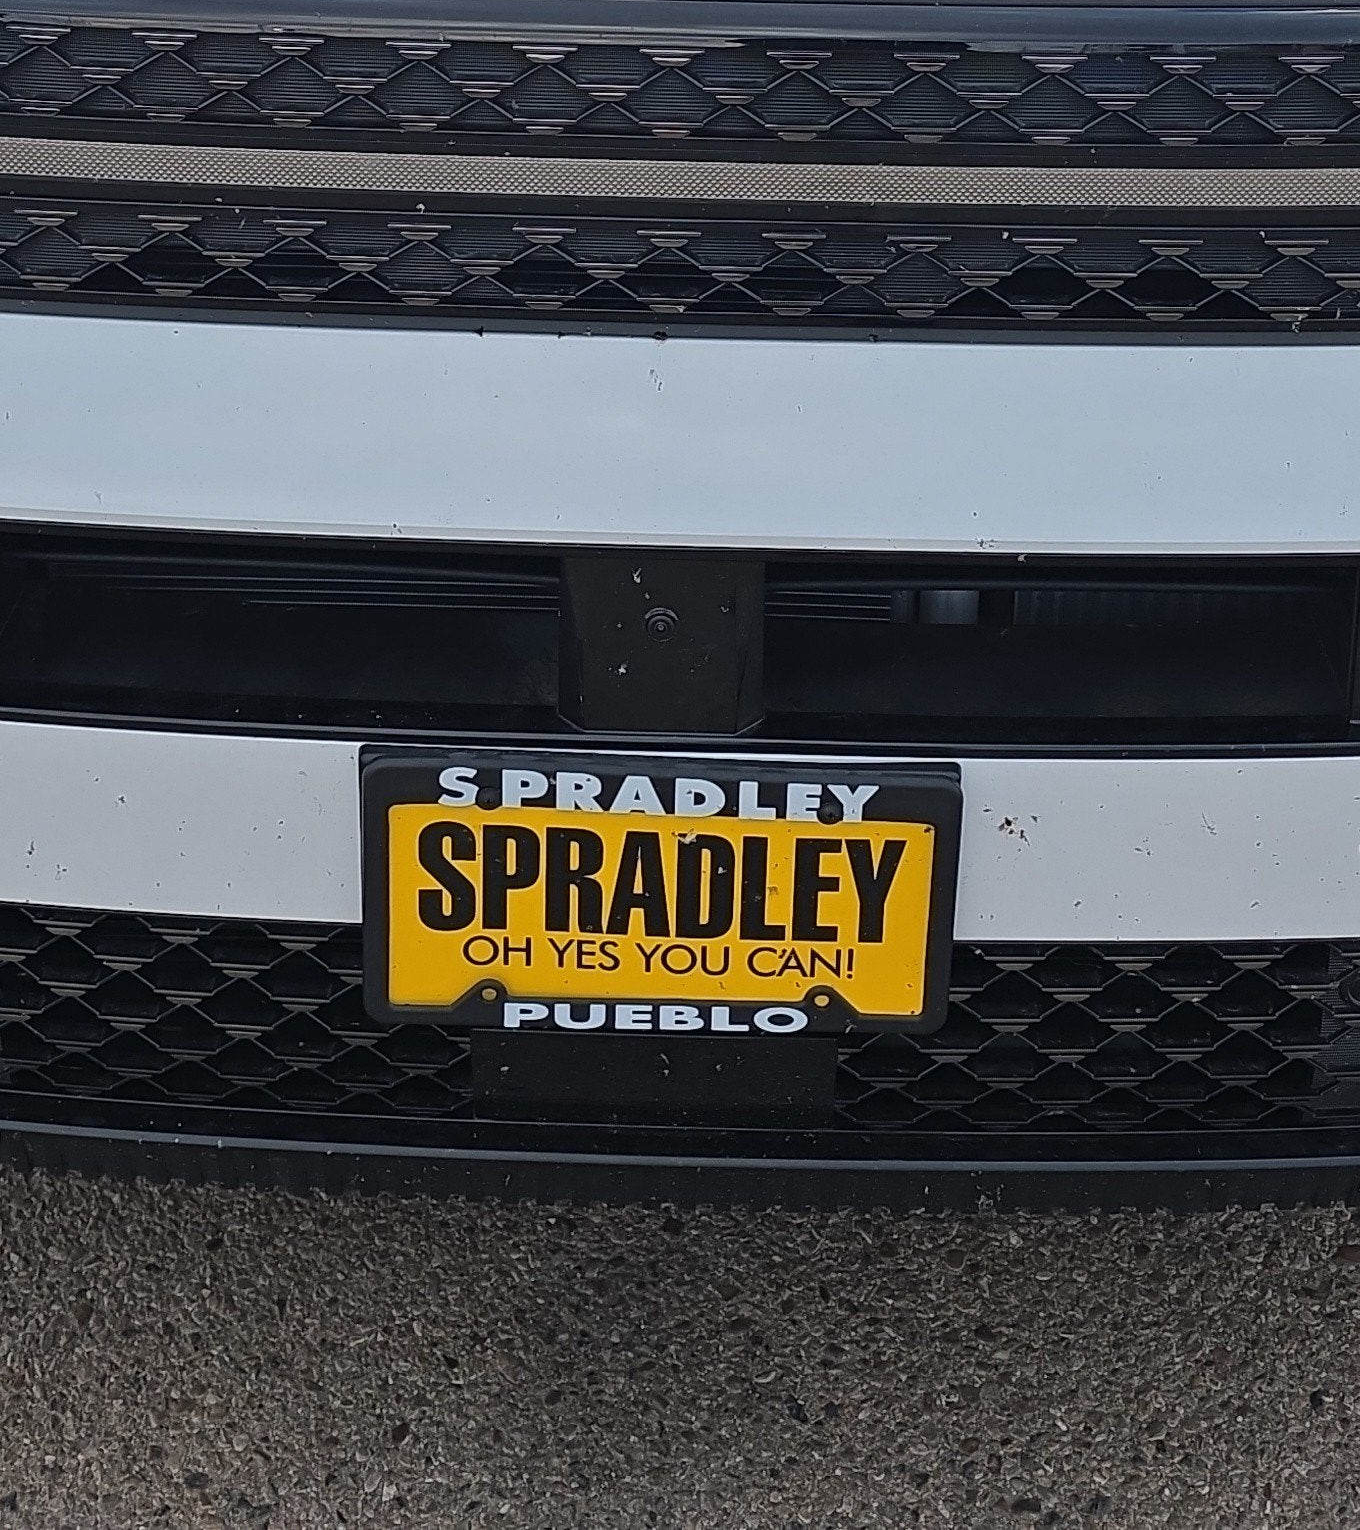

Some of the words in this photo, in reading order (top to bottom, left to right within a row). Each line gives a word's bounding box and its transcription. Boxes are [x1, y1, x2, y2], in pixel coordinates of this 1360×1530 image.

[438, 766, 880, 823] SPRADLEY
[418, 820, 908, 943] SPRADLEY
[462, 935, 532, 967] OH
[547, 938, 621, 971] YES
[635, 941, 731, 974] YOU
[746, 946, 856, 980] CAN!
[502, 1002, 809, 1033] PUEBLO
